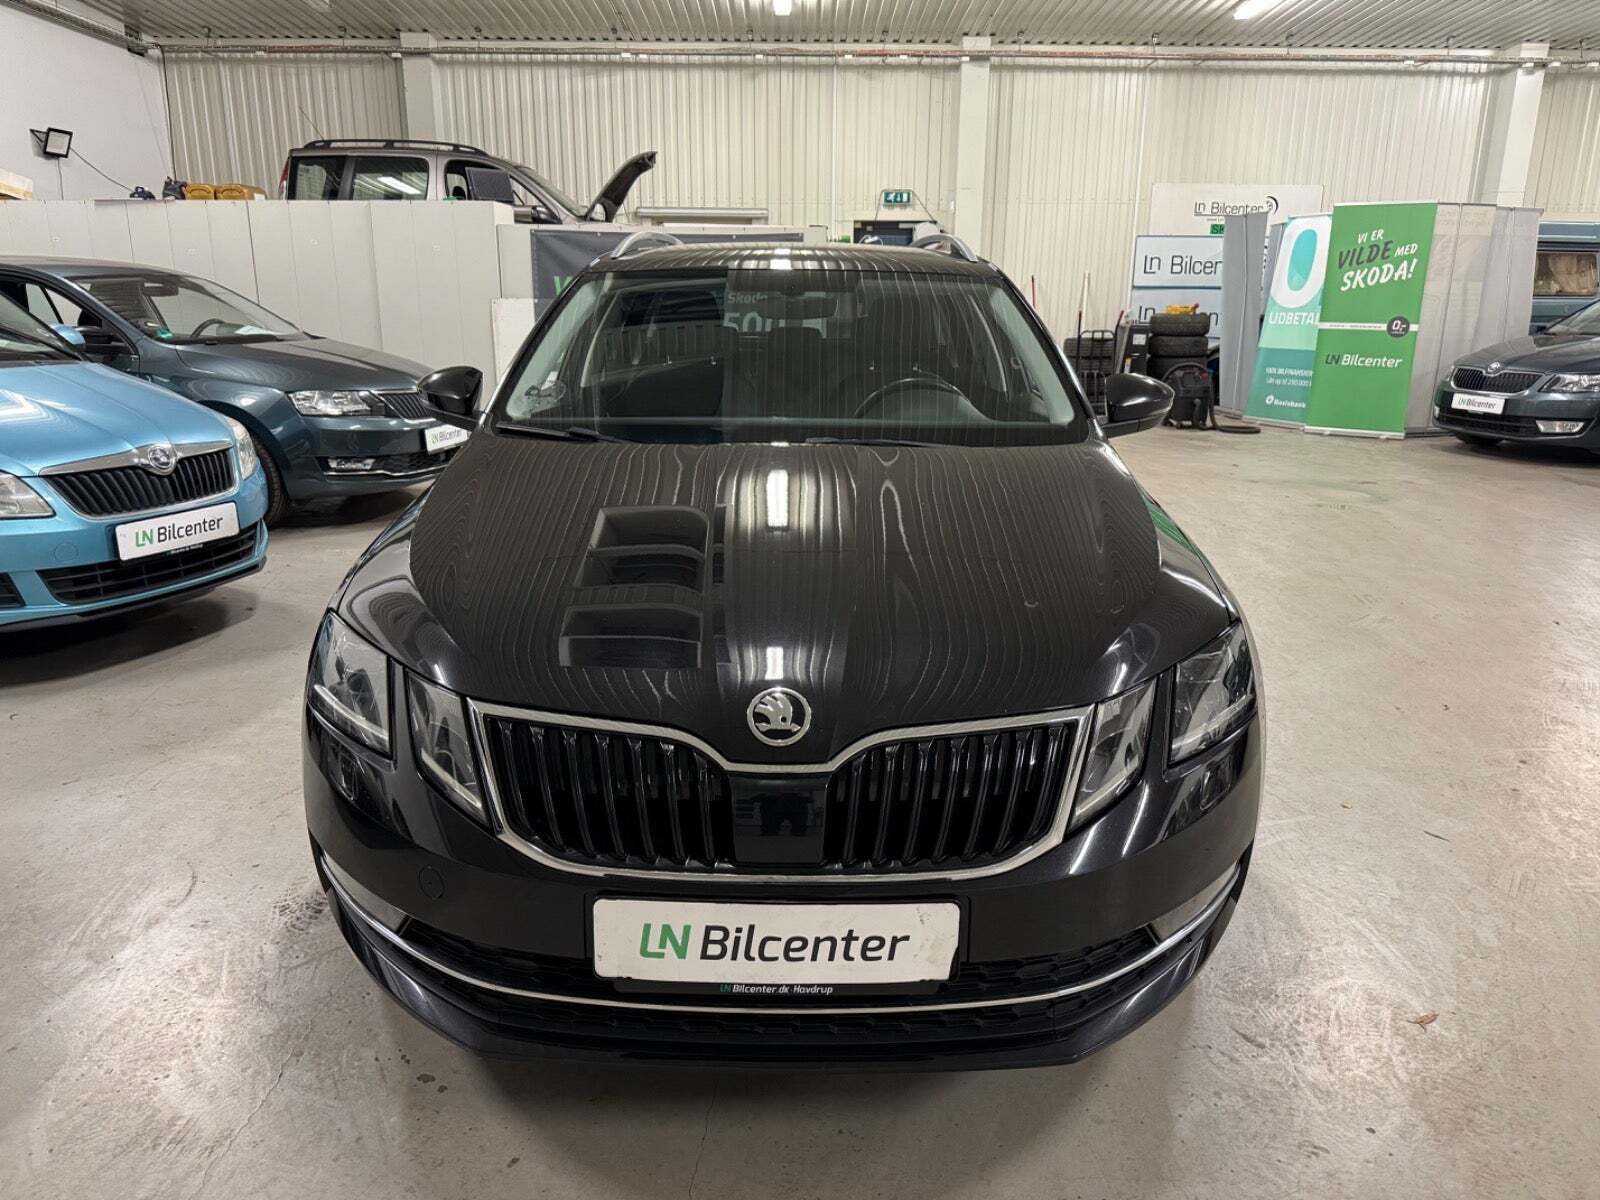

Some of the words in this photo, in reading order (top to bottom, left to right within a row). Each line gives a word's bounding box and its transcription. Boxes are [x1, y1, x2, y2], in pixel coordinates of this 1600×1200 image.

[1210, 201, 1264, 214] Bilcenter
[1357, 232, 1368, 244] VI
[1370, 229, 1384, 241] ER
[1338, 240, 1394, 270] VILDE
[1394, 243, 1418, 257] MED
[1340, 258, 1418, 291] SKODA!
[1325, 353, 1341, 365] LN
[1341, 354, 1402, 368] Bilcenter
[1466, 398, 1497, 409] Bilcenter
[135, 528, 154, 547] LN
[157, 517, 223, 543] Bilcenter
[639, 923, 692, 960] LN
[700, 924, 910, 962] Bilcenter
[793, 985, 834, 996] Havdrup
